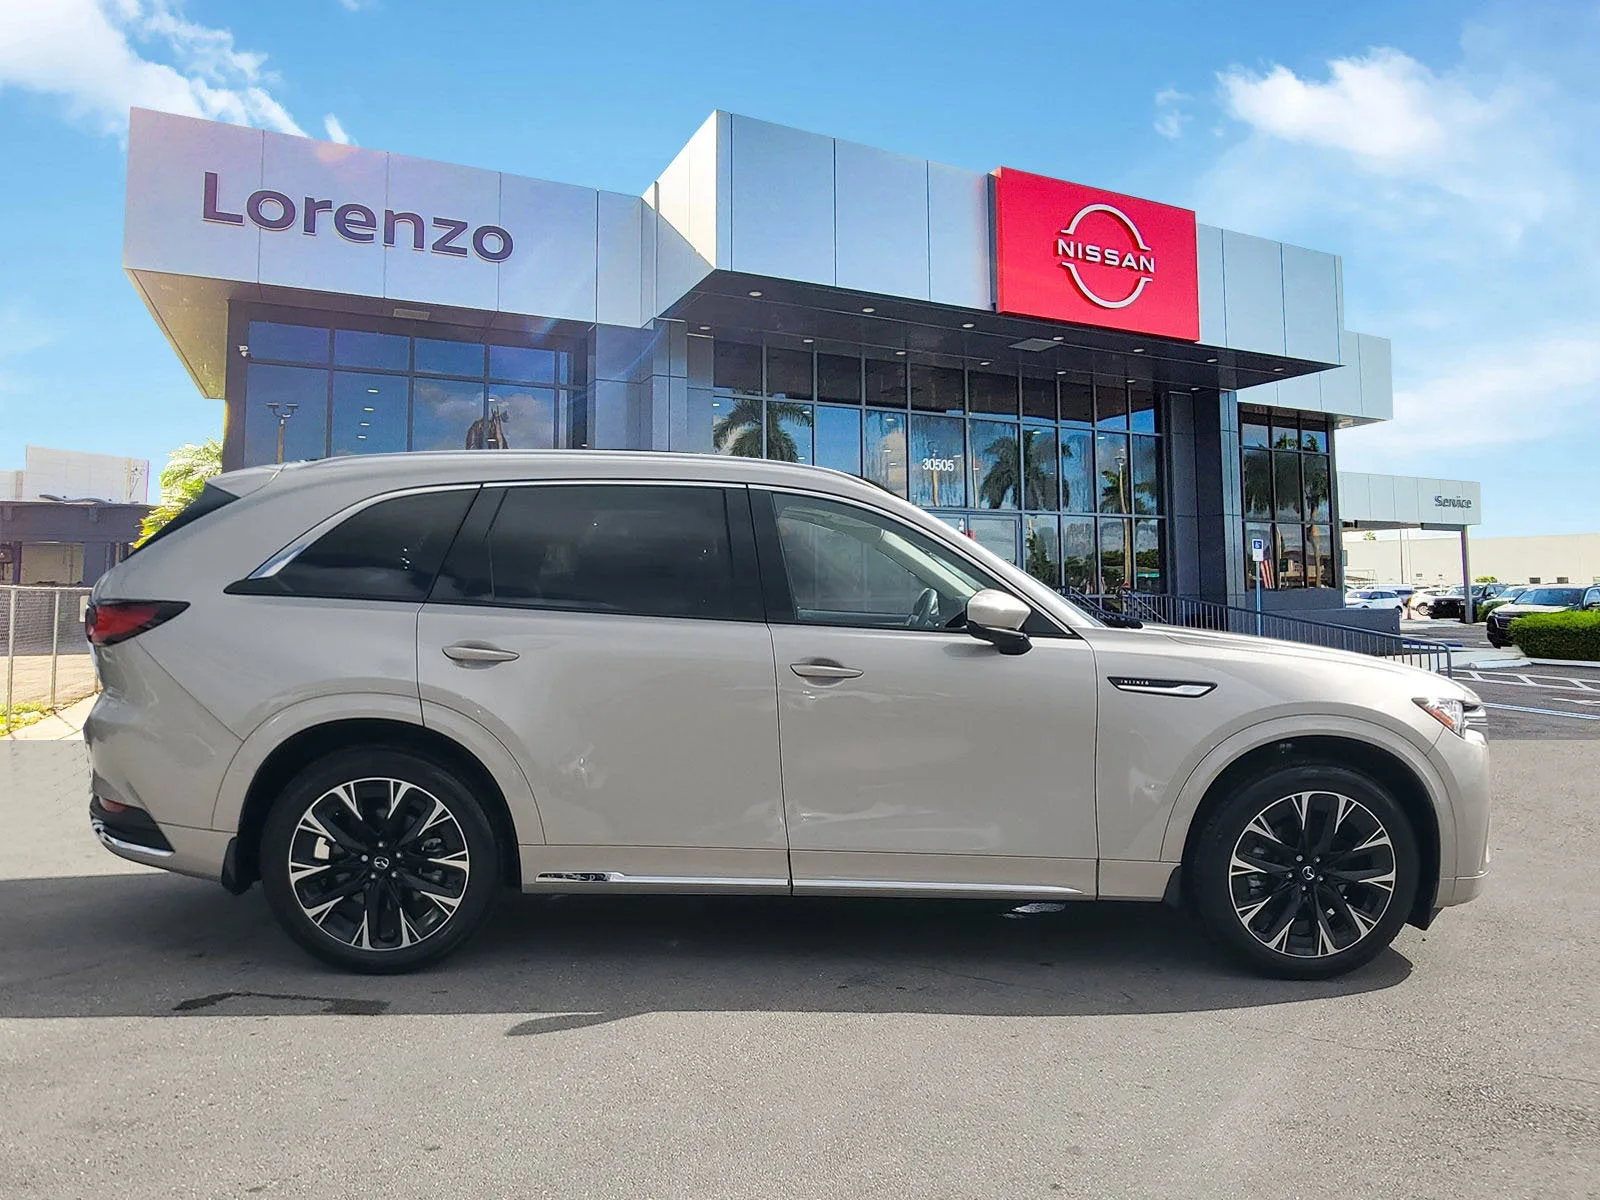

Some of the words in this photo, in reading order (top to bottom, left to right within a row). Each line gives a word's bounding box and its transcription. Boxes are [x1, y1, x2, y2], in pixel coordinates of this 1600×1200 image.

[202, 171, 514, 262] Lorenzo
[1057, 238, 1155, 273] NISSAN
[922, 458, 954, 472] 30505
[1434, 495, 1472, 509] Service
